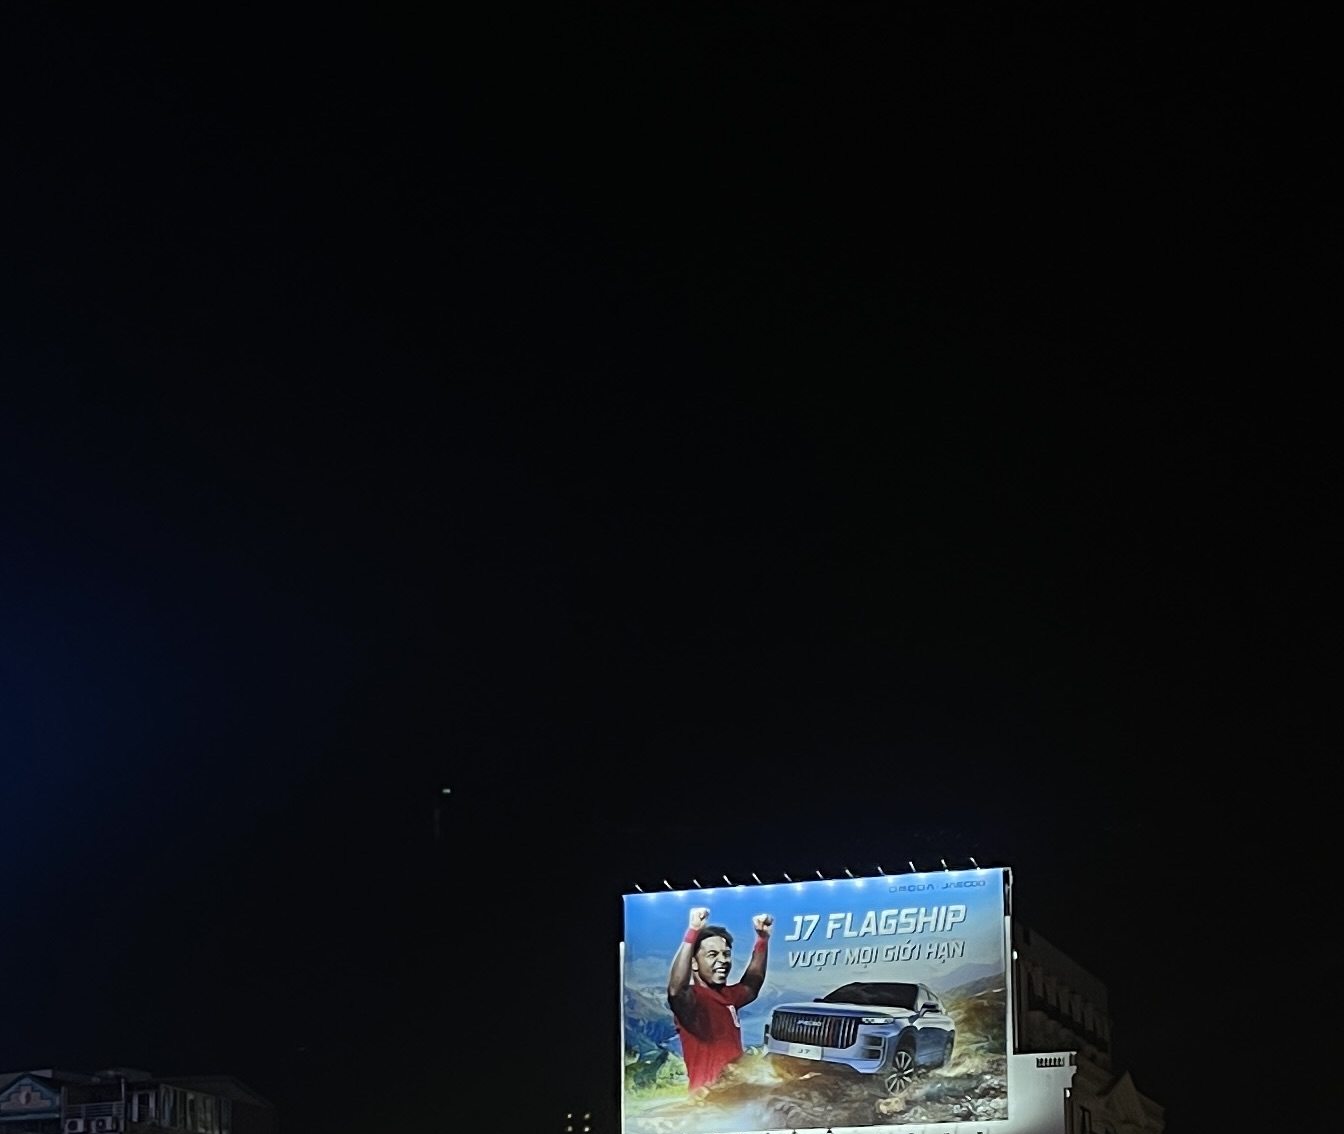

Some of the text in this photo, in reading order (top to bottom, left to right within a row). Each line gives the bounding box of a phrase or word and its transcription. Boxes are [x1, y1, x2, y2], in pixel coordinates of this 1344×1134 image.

[784, 903, 968, 942] J7 FLAGSHIP
[787, 939, 966, 972] VƯỢT MỌI GIỚI HẠN
